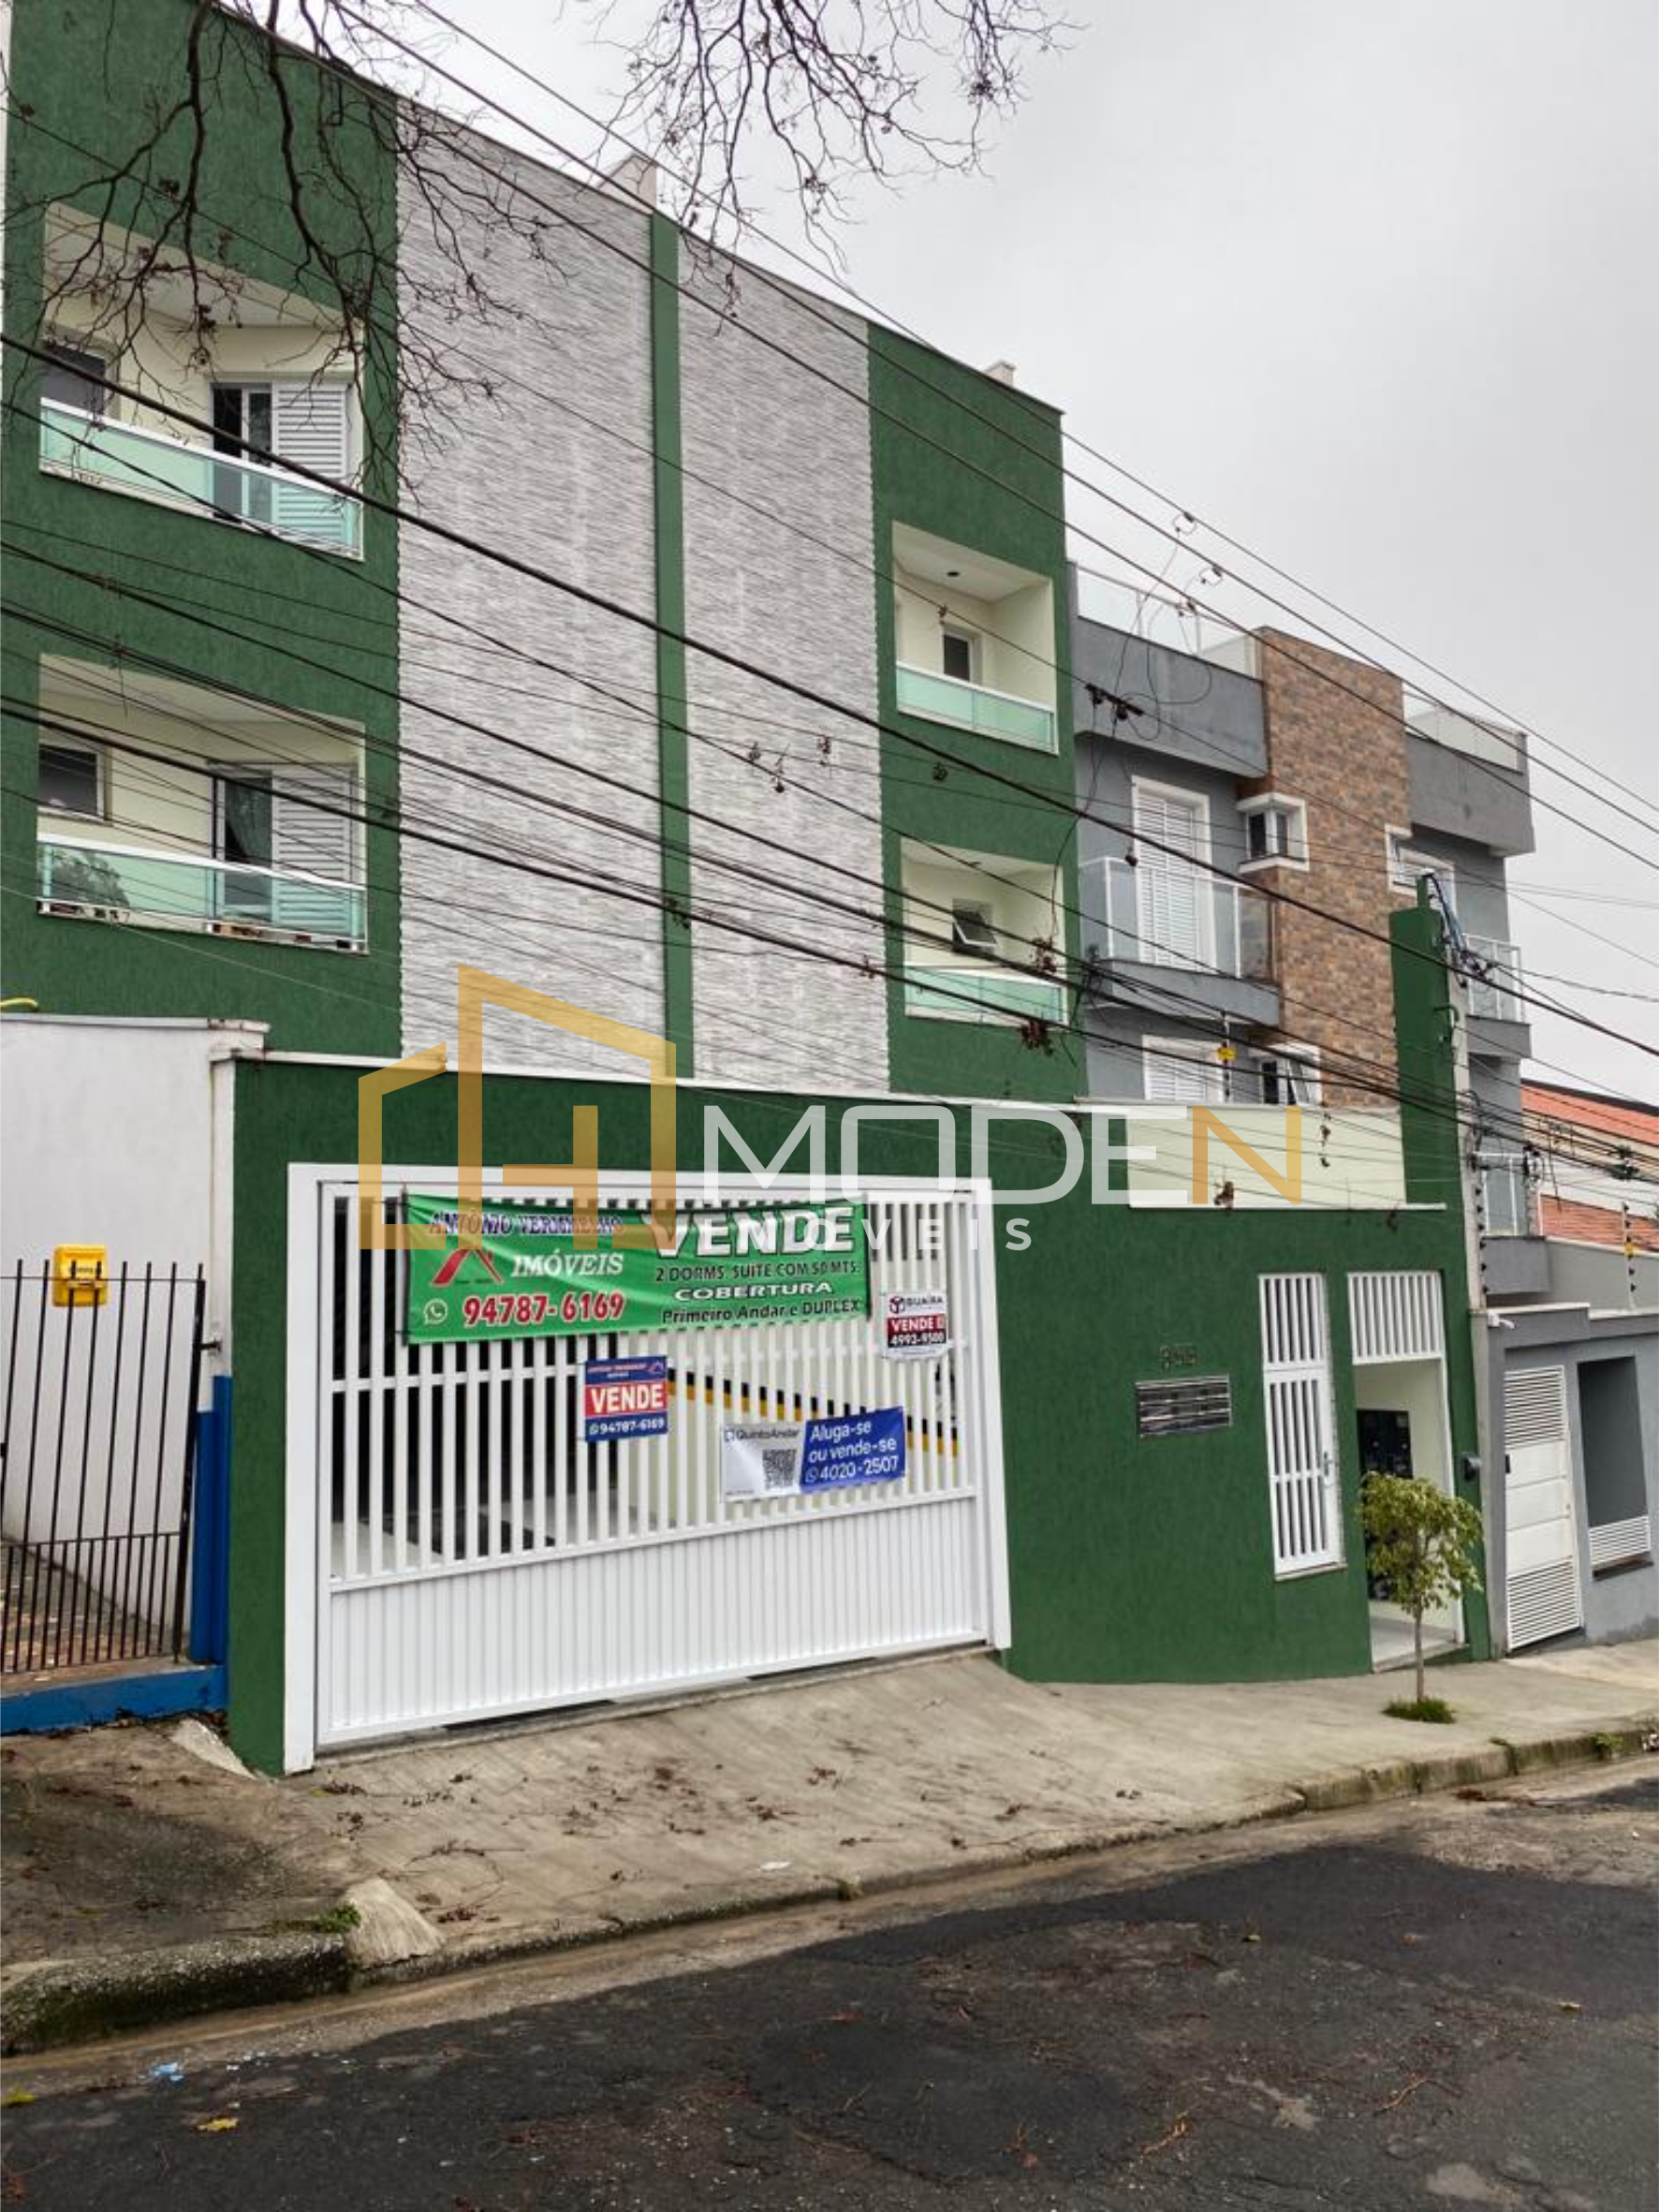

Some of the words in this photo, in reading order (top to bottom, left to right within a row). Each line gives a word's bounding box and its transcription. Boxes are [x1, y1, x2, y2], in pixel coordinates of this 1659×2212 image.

[641, 1206, 854, 1258] VENDE
[510, 1248, 624, 1278] IMÓVEIS
[655, 1267, 665, 1282] 2
[776, 1262, 809, 1276] COM
[673, 1281, 833, 1302] COBERTURA
[662, 1307, 732, 1325] Primeiro
[736, 1305, 785, 1320] Andar
[802, 1298, 860, 1316] DUPLEX
[890, 1317, 934, 1333] VENDE
[591, 1384, 665, 1414] VENDE
[736, 1425, 800, 1440] QuintoAndar
[809, 1421, 873, 1443] Aluga-se
[808, 1450, 828, 1464] ou
[830, 1438, 898, 1460] vende-se
[819, 1455, 899, 1481] 4020-2507
